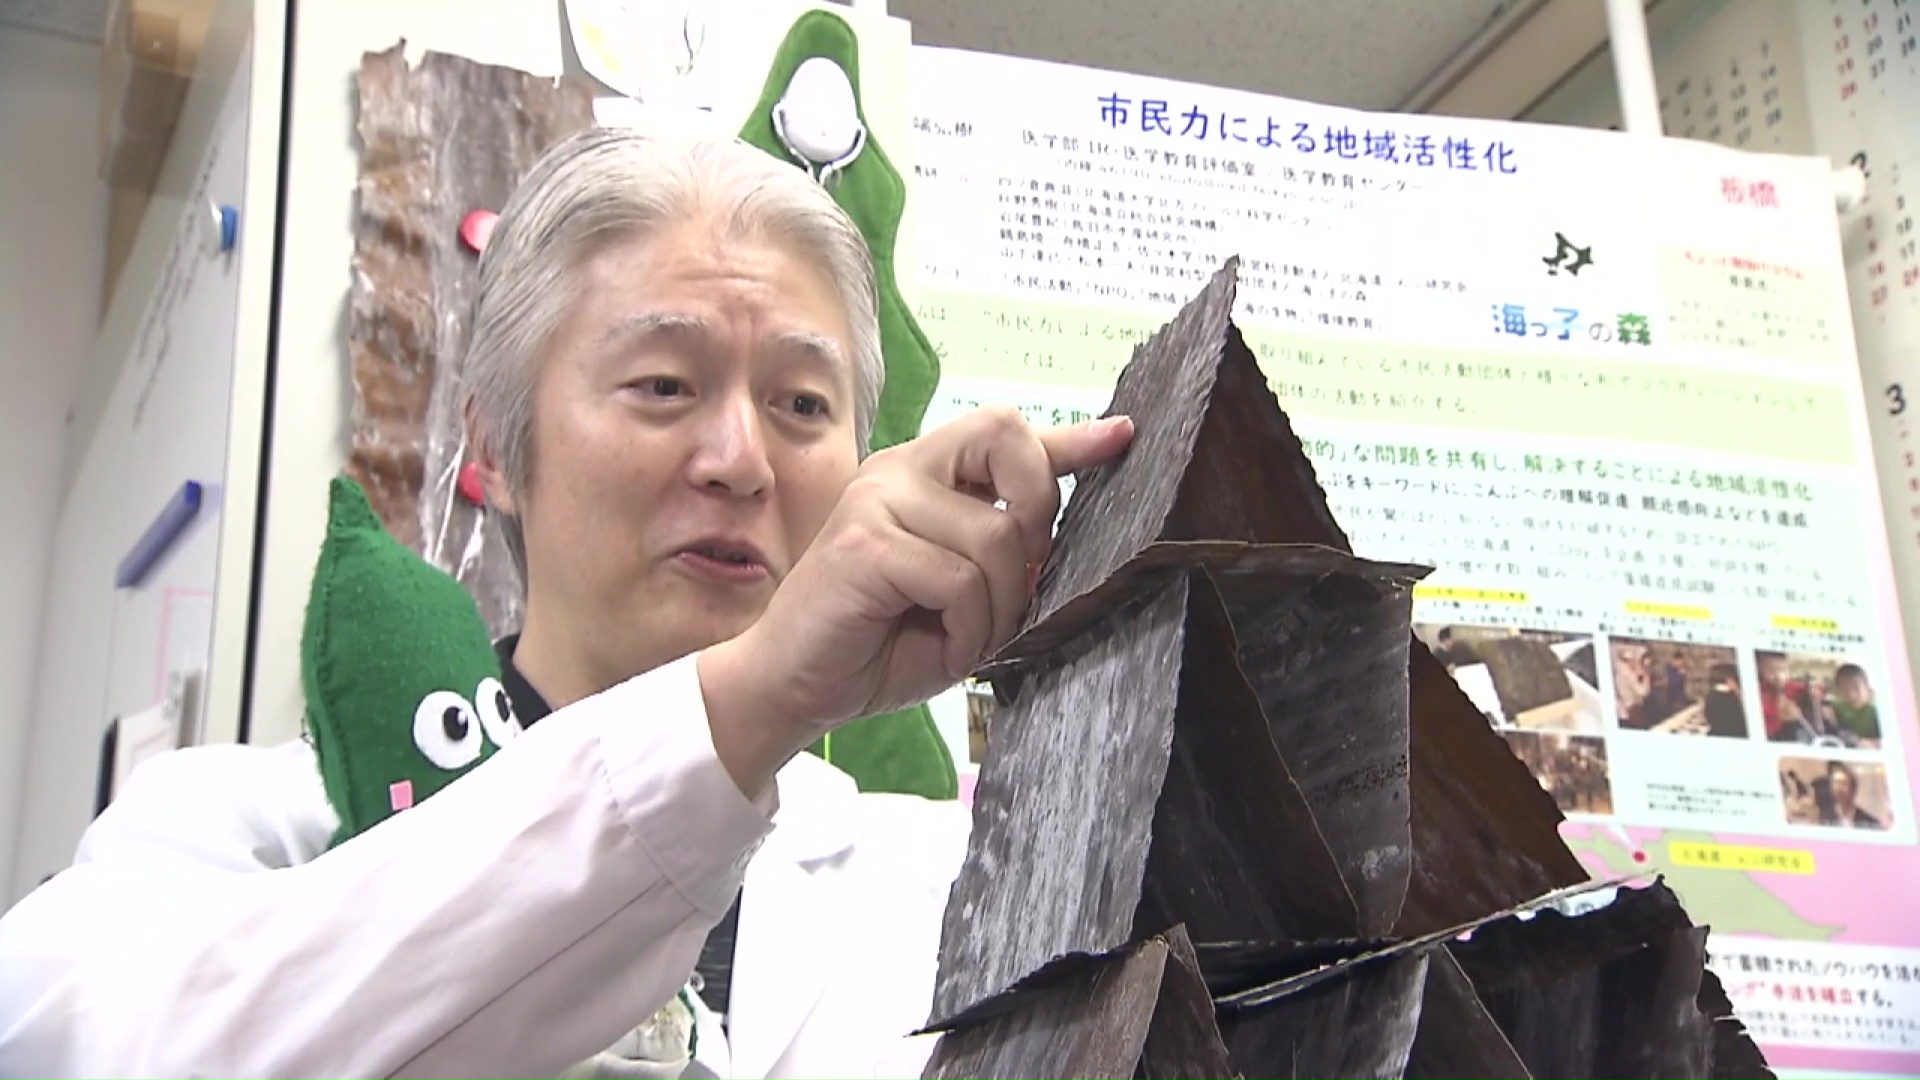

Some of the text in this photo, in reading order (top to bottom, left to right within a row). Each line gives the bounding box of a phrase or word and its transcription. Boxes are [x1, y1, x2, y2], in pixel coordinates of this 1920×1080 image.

[1098, 92, 1518, 175] 市民力による地域活性化
[1492, 303, 1652, 345] 海っ子の森
[1885, 383, 1906, 416] 3
